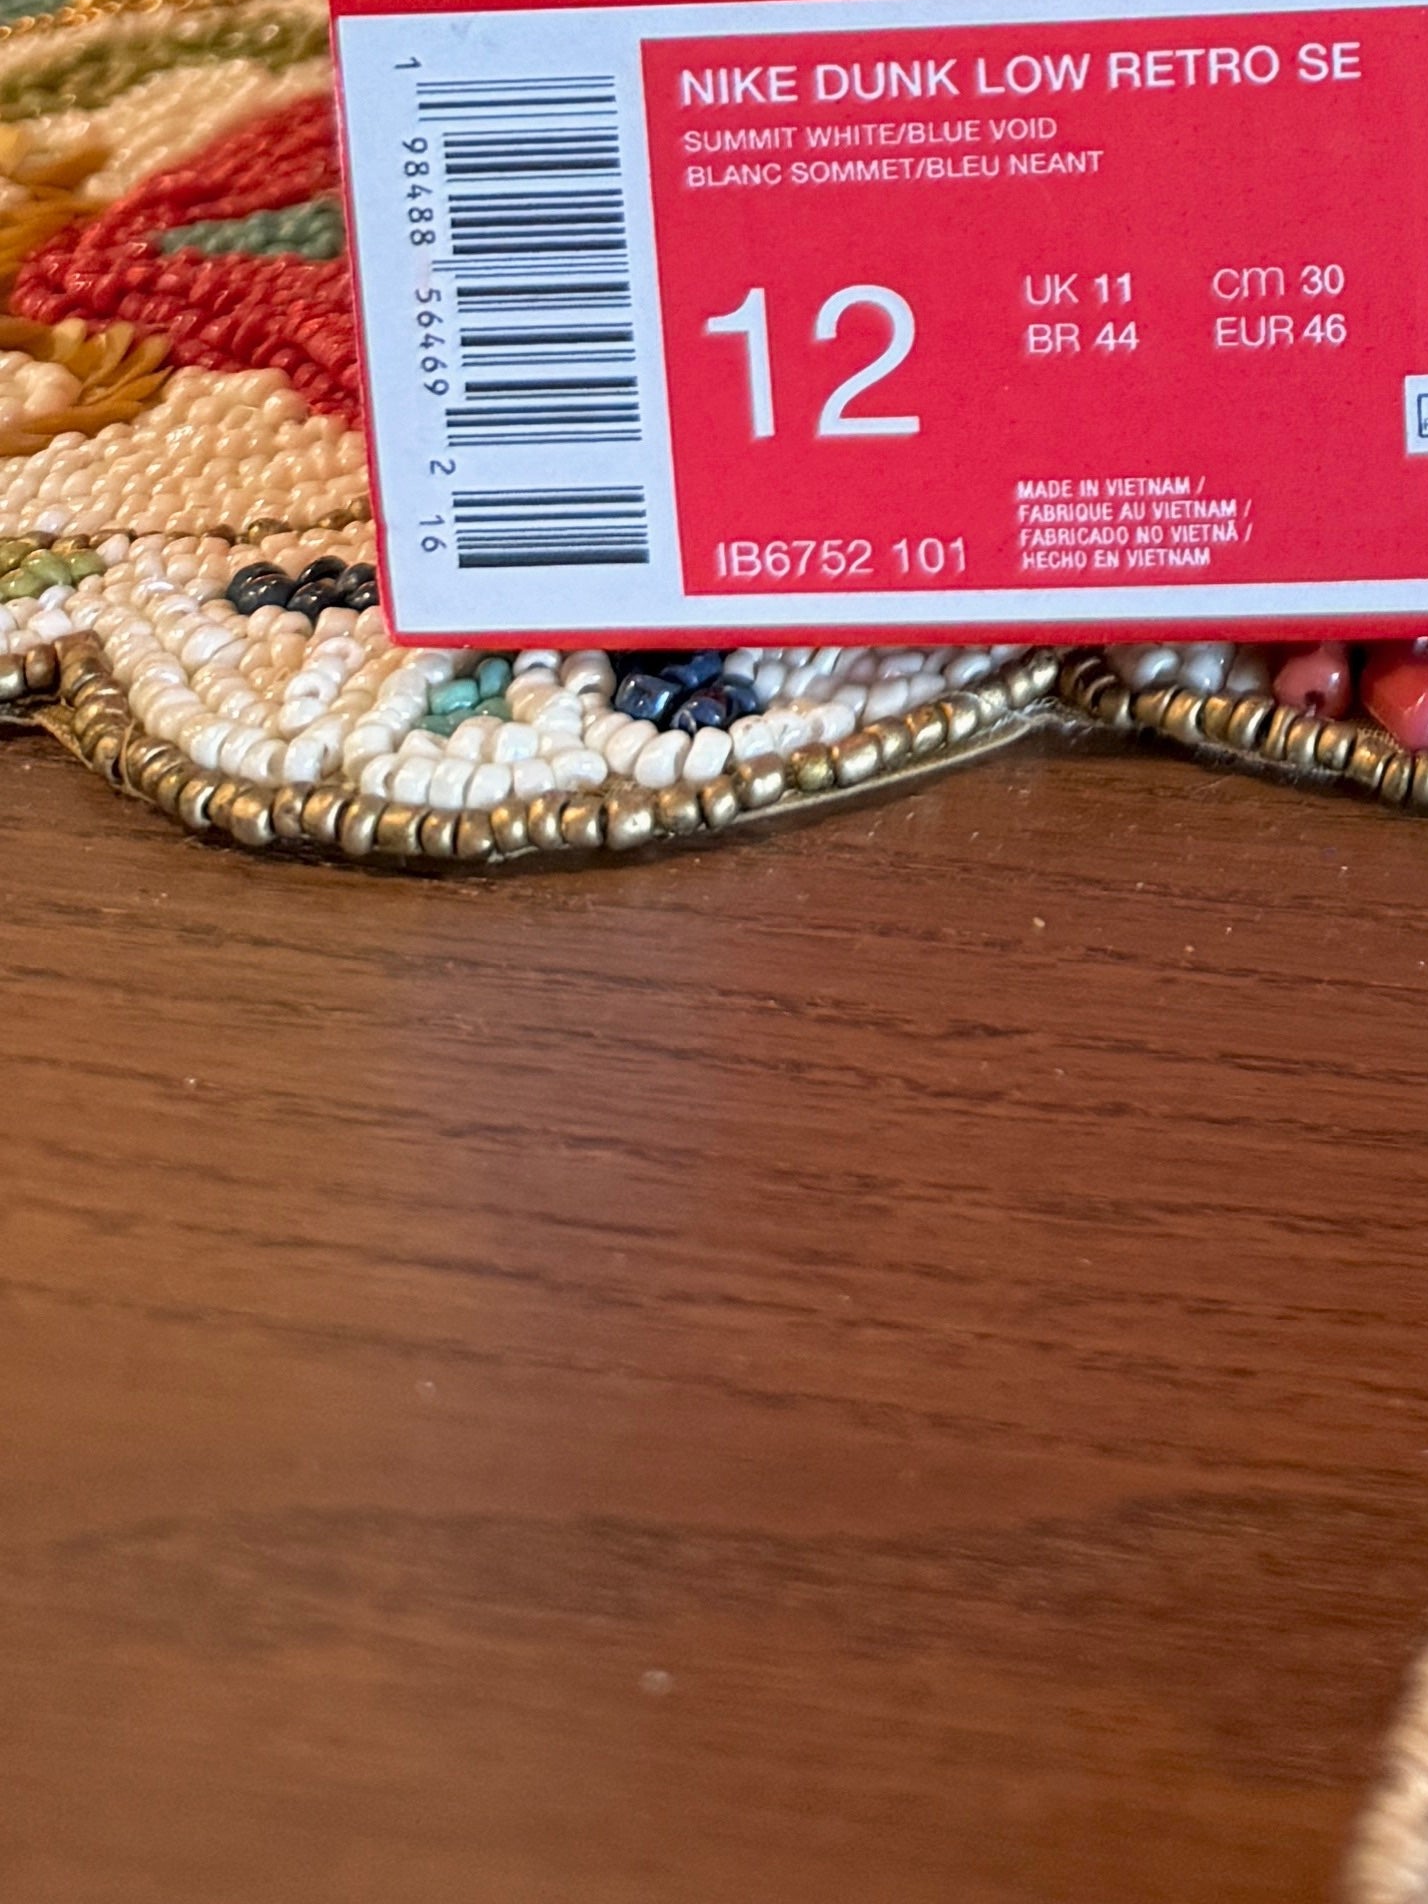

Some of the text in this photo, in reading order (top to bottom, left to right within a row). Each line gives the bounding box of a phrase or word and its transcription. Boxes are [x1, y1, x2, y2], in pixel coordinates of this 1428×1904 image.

[681, 42, 1362, 105] NIKE DUNK LOW RETRO SE
[684, 117, 1058, 153] SUMMIT WHITE/BLUE VOID
[686, 150, 1104, 188] BLANC SOMMET/BLEU NEANT
[1025, 272, 1132, 306] UK 11
[1213, 264, 1345, 299] cm 30
[394, 56, 456, 553] 1 98488 56469 2 16
[1027, 321, 1139, 353] BR 44
[1215, 313, 1347, 346] EUR 46
[706, 284, 921, 438] 12
[1017, 480, 1072, 498] MADE
[1080, 479, 1099, 497] IN
[1106, 476, 1190, 496] VIETNAM
[1018, 502, 1113, 522] FABRIQUE
[1119, 502, 1145, 520] AU
[1152, 499, 1237, 519] VIETNAM
[1020, 525, 1129, 547] FABRICADO
[1135, 525, 1163, 543] NO
[716, 537, 966, 577] IB6752 101
[1022, 547, 1211, 569] HECHO EN VIETNAM
